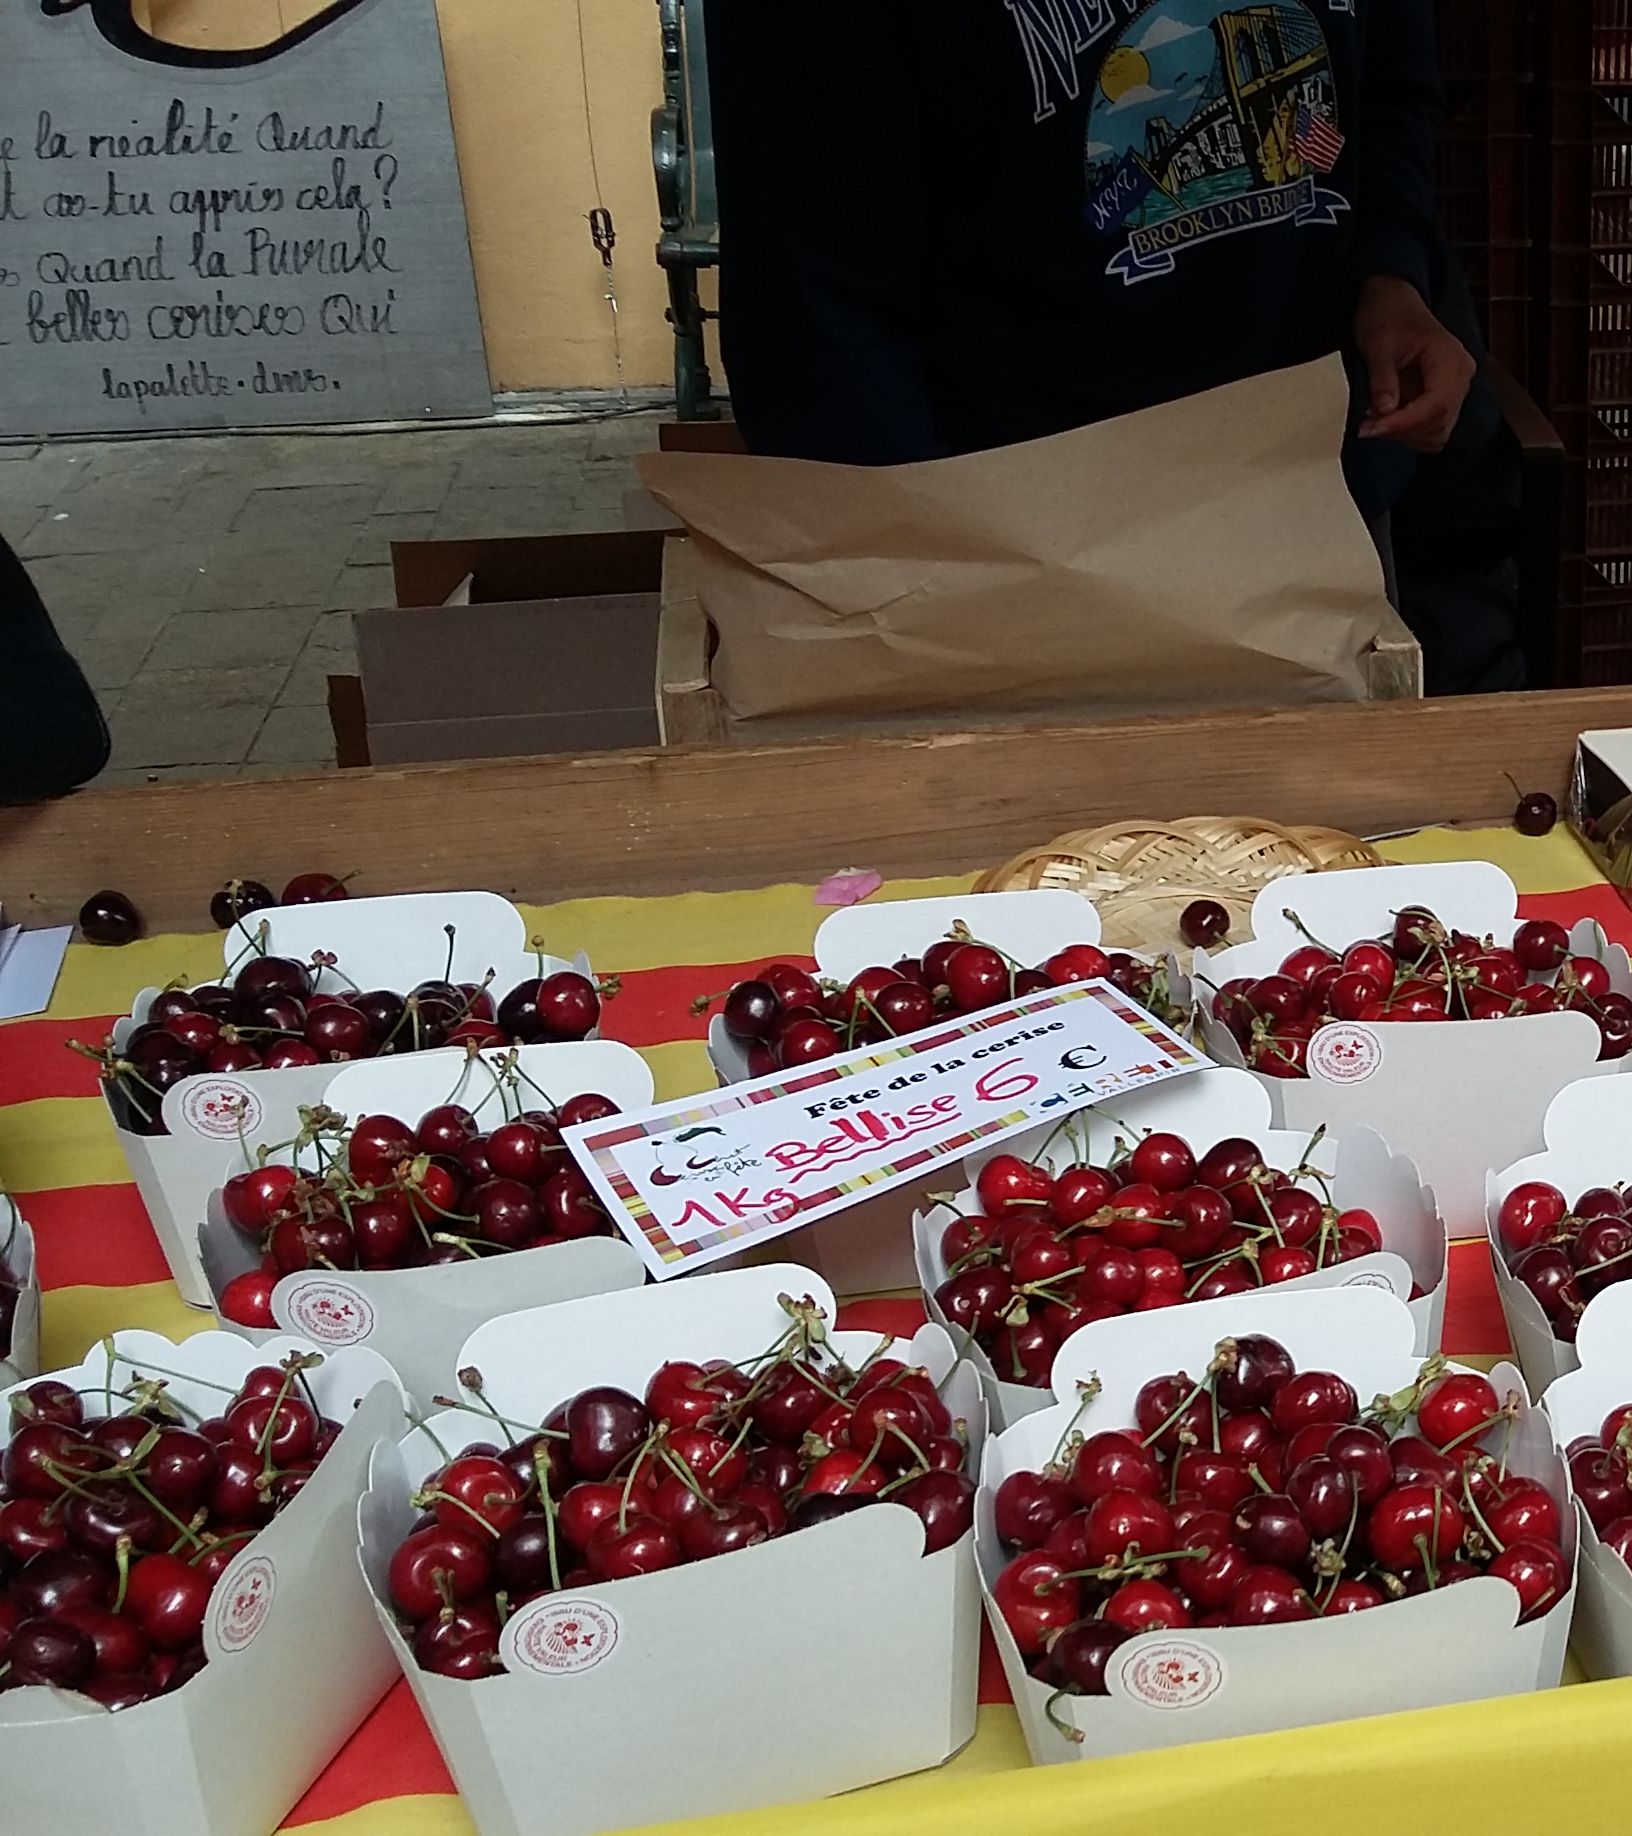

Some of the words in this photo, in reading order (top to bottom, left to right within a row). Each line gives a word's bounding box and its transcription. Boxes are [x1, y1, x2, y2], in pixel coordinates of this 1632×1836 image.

[35, 110, 79, 159] la
[257, 101, 392, 155] Quand
[1134, 199, 1253, 254] BROOKLYN
[37, 235, 174, 284] Quand
[188, 231, 236, 279] la
[320, 289, 398, 335] Qui
[804, 1087, 881, 1119] Fête
[889, 1069, 928, 1092] de
[933, 1057, 966, 1075] la
[972, 1019, 1065, 1060] cerise
[765, 1094, 957, 1172] Bellise
[976, 1057, 1039, 1102] 6
[1058, 1045, 1107, 1070] €
